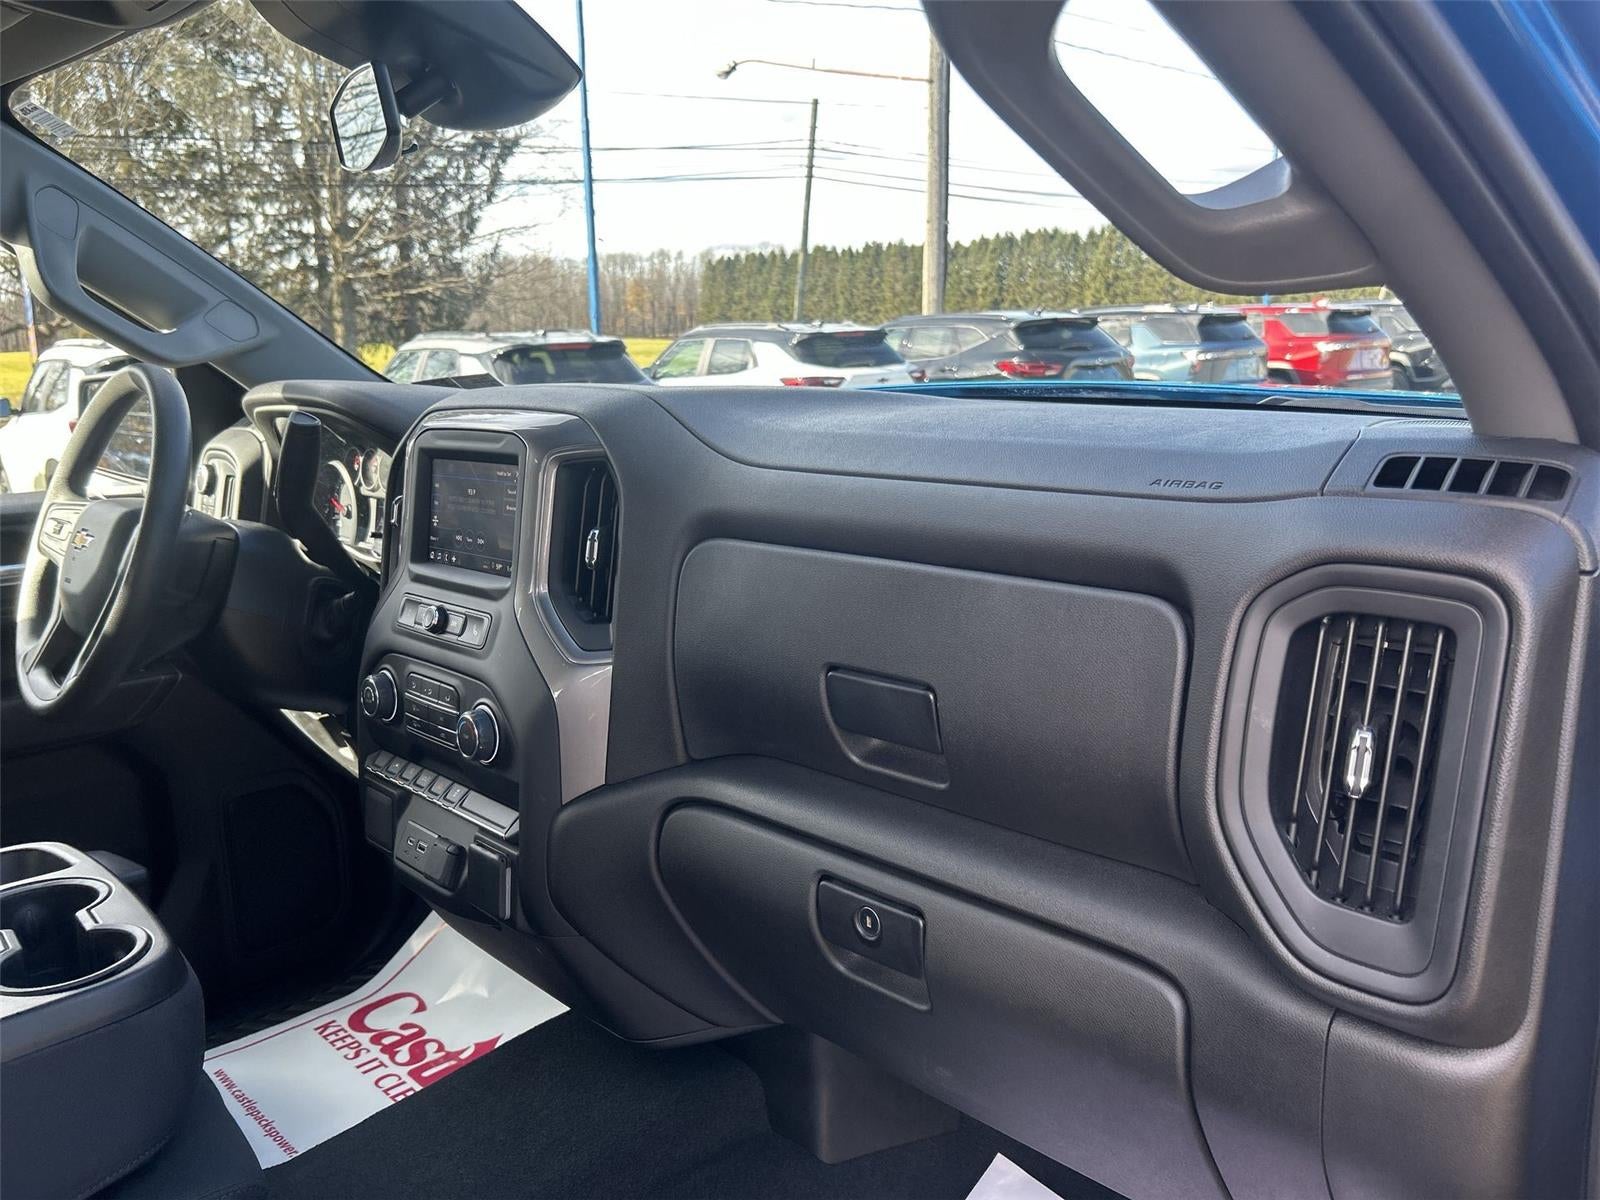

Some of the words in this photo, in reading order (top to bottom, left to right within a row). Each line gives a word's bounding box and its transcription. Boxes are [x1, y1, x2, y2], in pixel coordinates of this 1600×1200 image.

[1149, 479, 1224, 490] AIRBAG
[314, 1019, 371, 1061] KEEPS
[355, 1057, 388, 1075] IT
